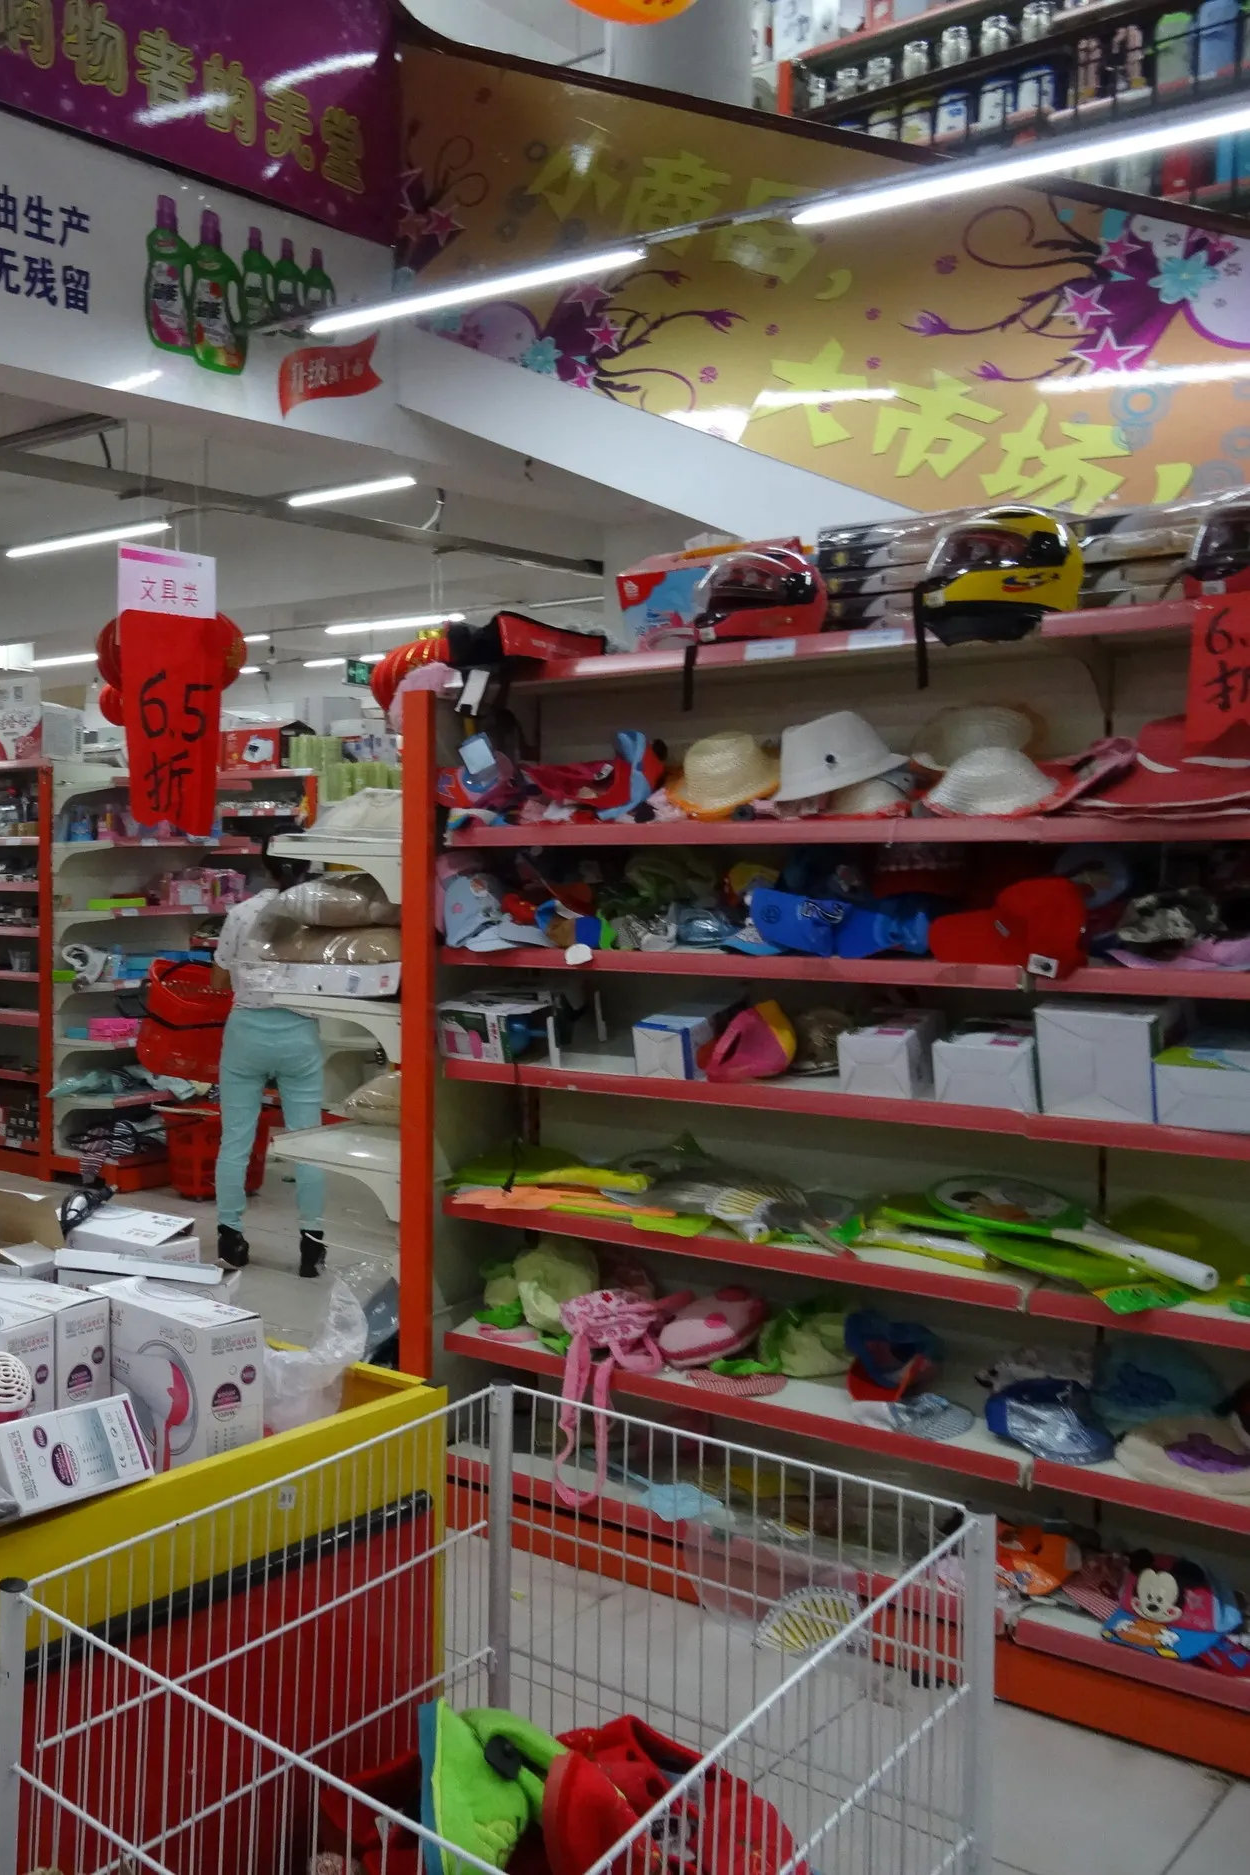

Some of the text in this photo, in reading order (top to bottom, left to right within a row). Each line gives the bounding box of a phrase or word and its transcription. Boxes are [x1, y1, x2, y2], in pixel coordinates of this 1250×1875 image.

[139, 575, 199, 608] 文具类
[138, 669, 214, 743] 6.5
[143, 749, 194, 819] 折
